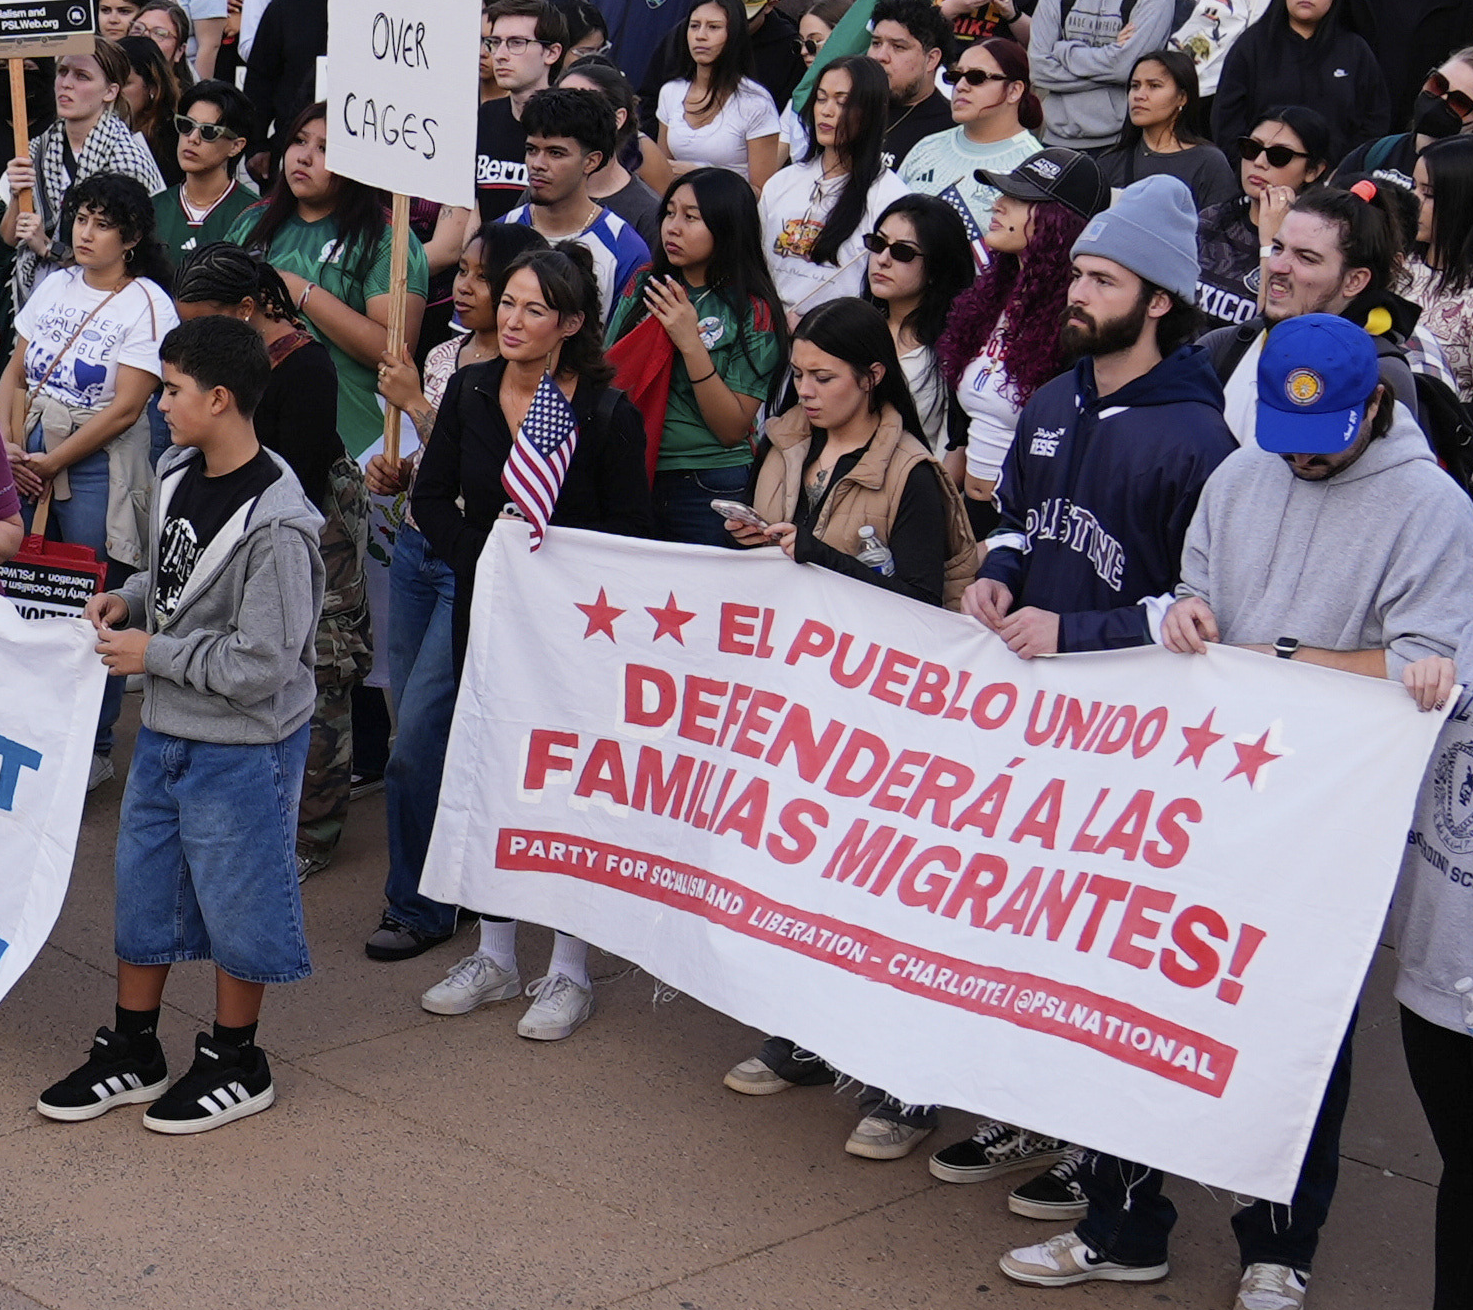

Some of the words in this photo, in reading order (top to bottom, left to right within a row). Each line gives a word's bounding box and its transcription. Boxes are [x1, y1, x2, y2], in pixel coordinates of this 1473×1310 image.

[1, 19, 59, 32] PSLWeb.org
[28, 7, 46, 17] and
[372, 12, 429, 70] OVER
[343, 92, 438, 160] CAGES
[718, 602, 775, 658] EL
[784, 619, 1018, 730] PUEBLO
[1024, 689, 1168, 759] UNIDO
[624, 663, 1025, 839] DEFENDERÁ
[1009, 777, 1065, 850] A
[1069, 787, 1203, 869] LAS
[523, 729, 829, 865] FAMILIAS
[821, 818, 1267, 1006] MIGRANTES!
[509, 835, 598, 868] PARTY
[606, 854, 647, 881] FOR
[650, 865, 705, 899] SOCIALISM
[705, 885, 744, 915] AND
[748, 906, 869, 964] LIBERATION
[887, 952, 1005, 1007] CHARLOTTE
[1014, 991, 1216, 1080] @PSLNATIONAL
